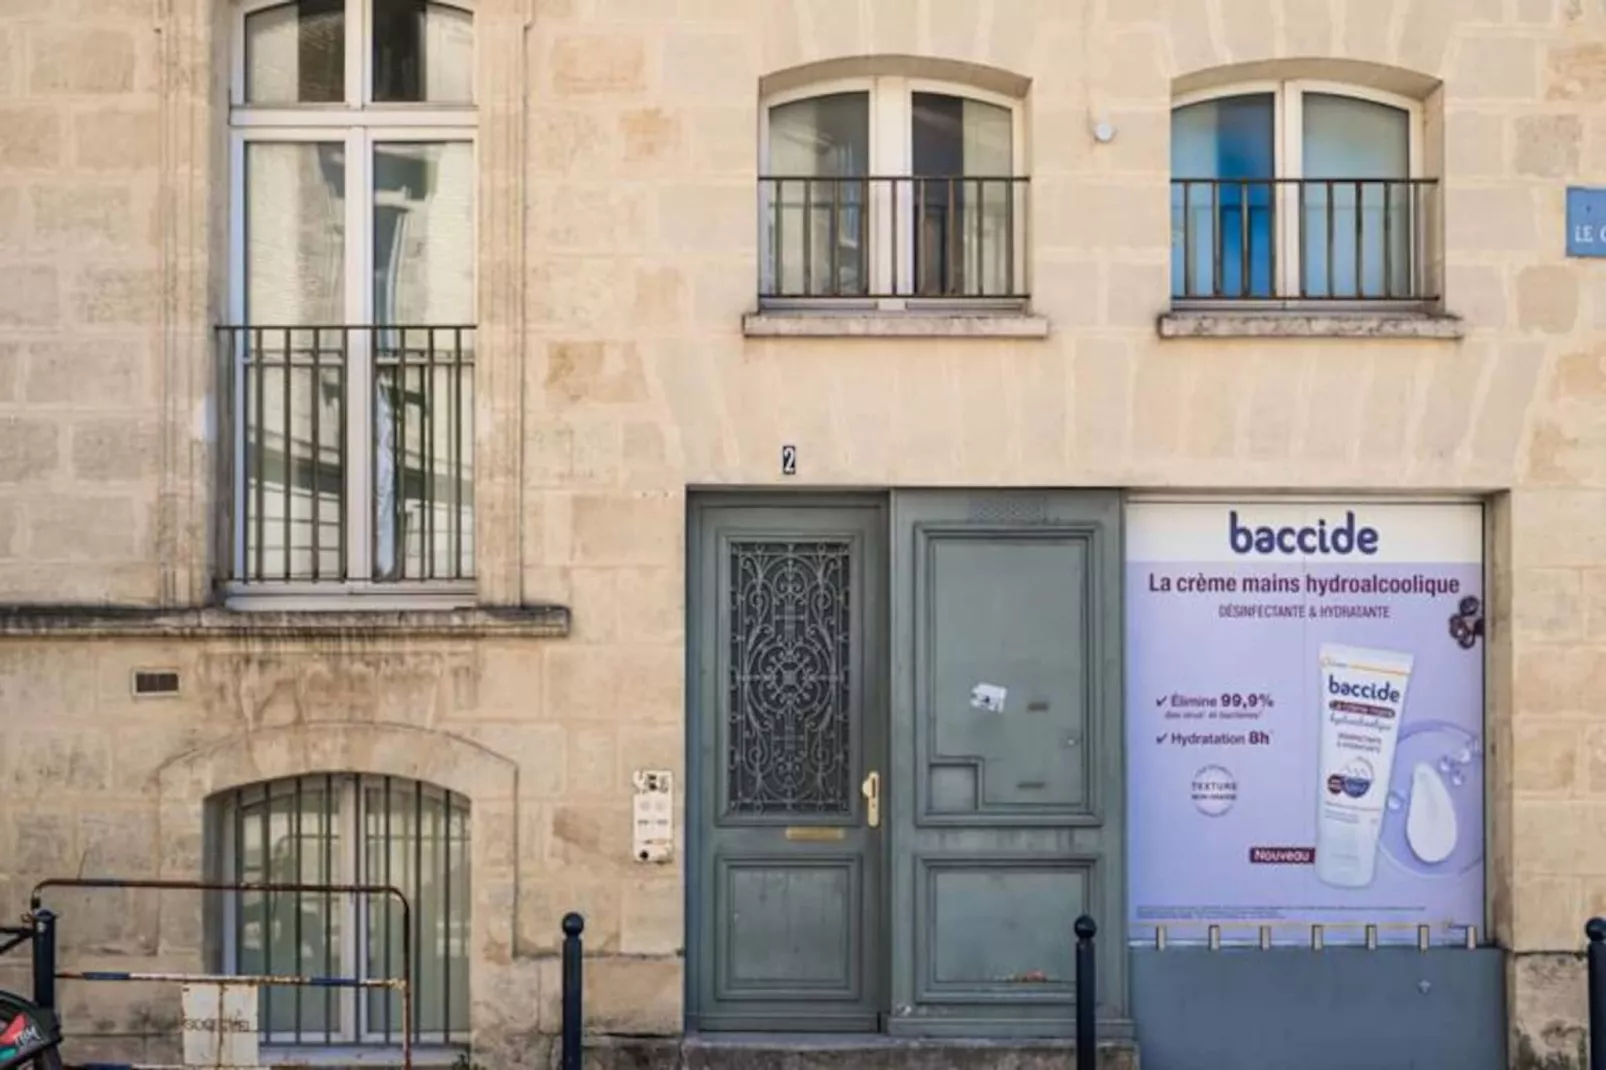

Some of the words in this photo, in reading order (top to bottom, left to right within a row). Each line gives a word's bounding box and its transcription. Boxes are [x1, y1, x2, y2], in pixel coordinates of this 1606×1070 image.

[1575, 225, 1594, 243] LE
[783, 446, 795, 473] 2
[1229, 510, 1379, 554] baccide
[1148, 573, 1171, 592] La
[1176, 571, 1236, 593] crème
[1242, 573, 1300, 593] mains
[1305, 573, 1460, 597] hydroalcoolique
[1309, 605, 1317, 618] &
[1320, 604, 1390, 619] HYDRATANTE
[1328, 674, 1401, 704] baccide
[1220, 693, 1274, 709] 99,9%
[1171, 732, 1245, 747] Hydratation
[1254, 848, 1310, 862] Nouveau
